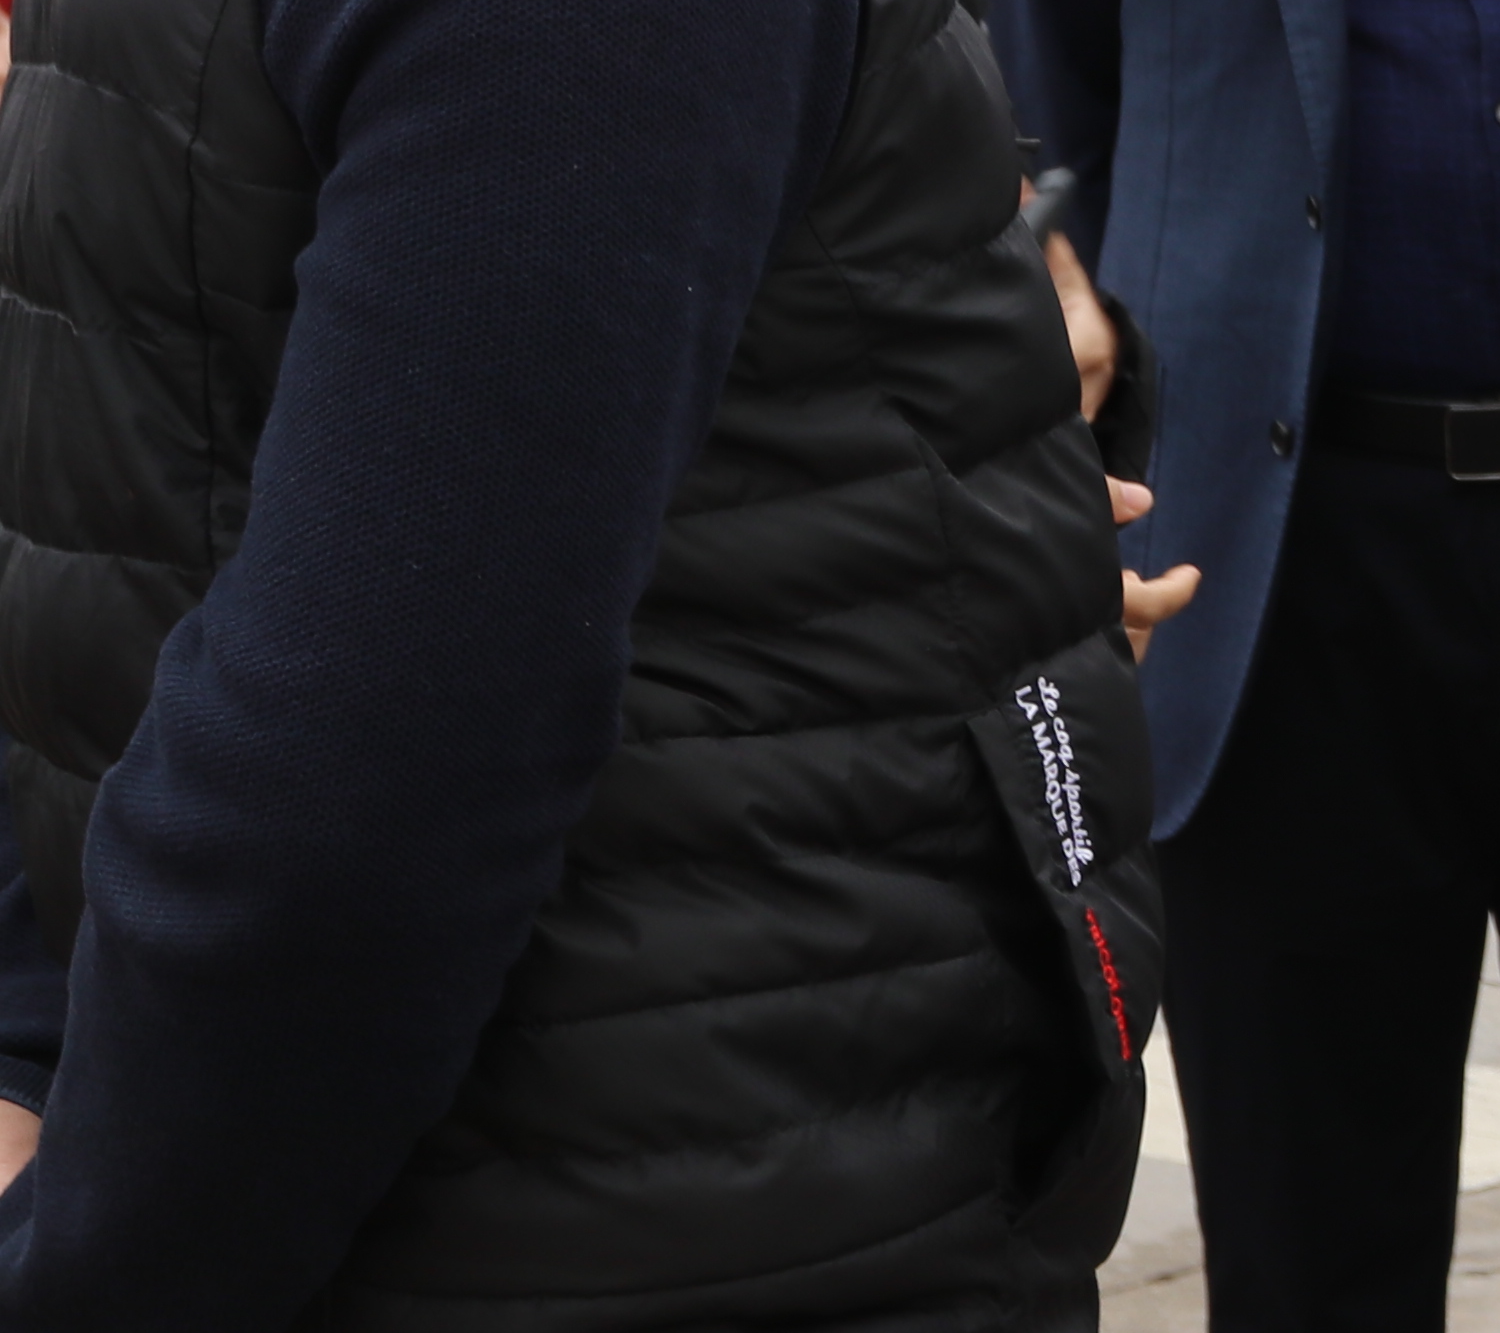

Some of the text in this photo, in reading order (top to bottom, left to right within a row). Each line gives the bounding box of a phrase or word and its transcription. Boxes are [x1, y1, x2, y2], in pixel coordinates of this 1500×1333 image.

[1015, 685, 1039, 721] LA
[1032, 720, 1069, 836] MARQUE
[1038, 676, 1094, 866] Le coq sportif
